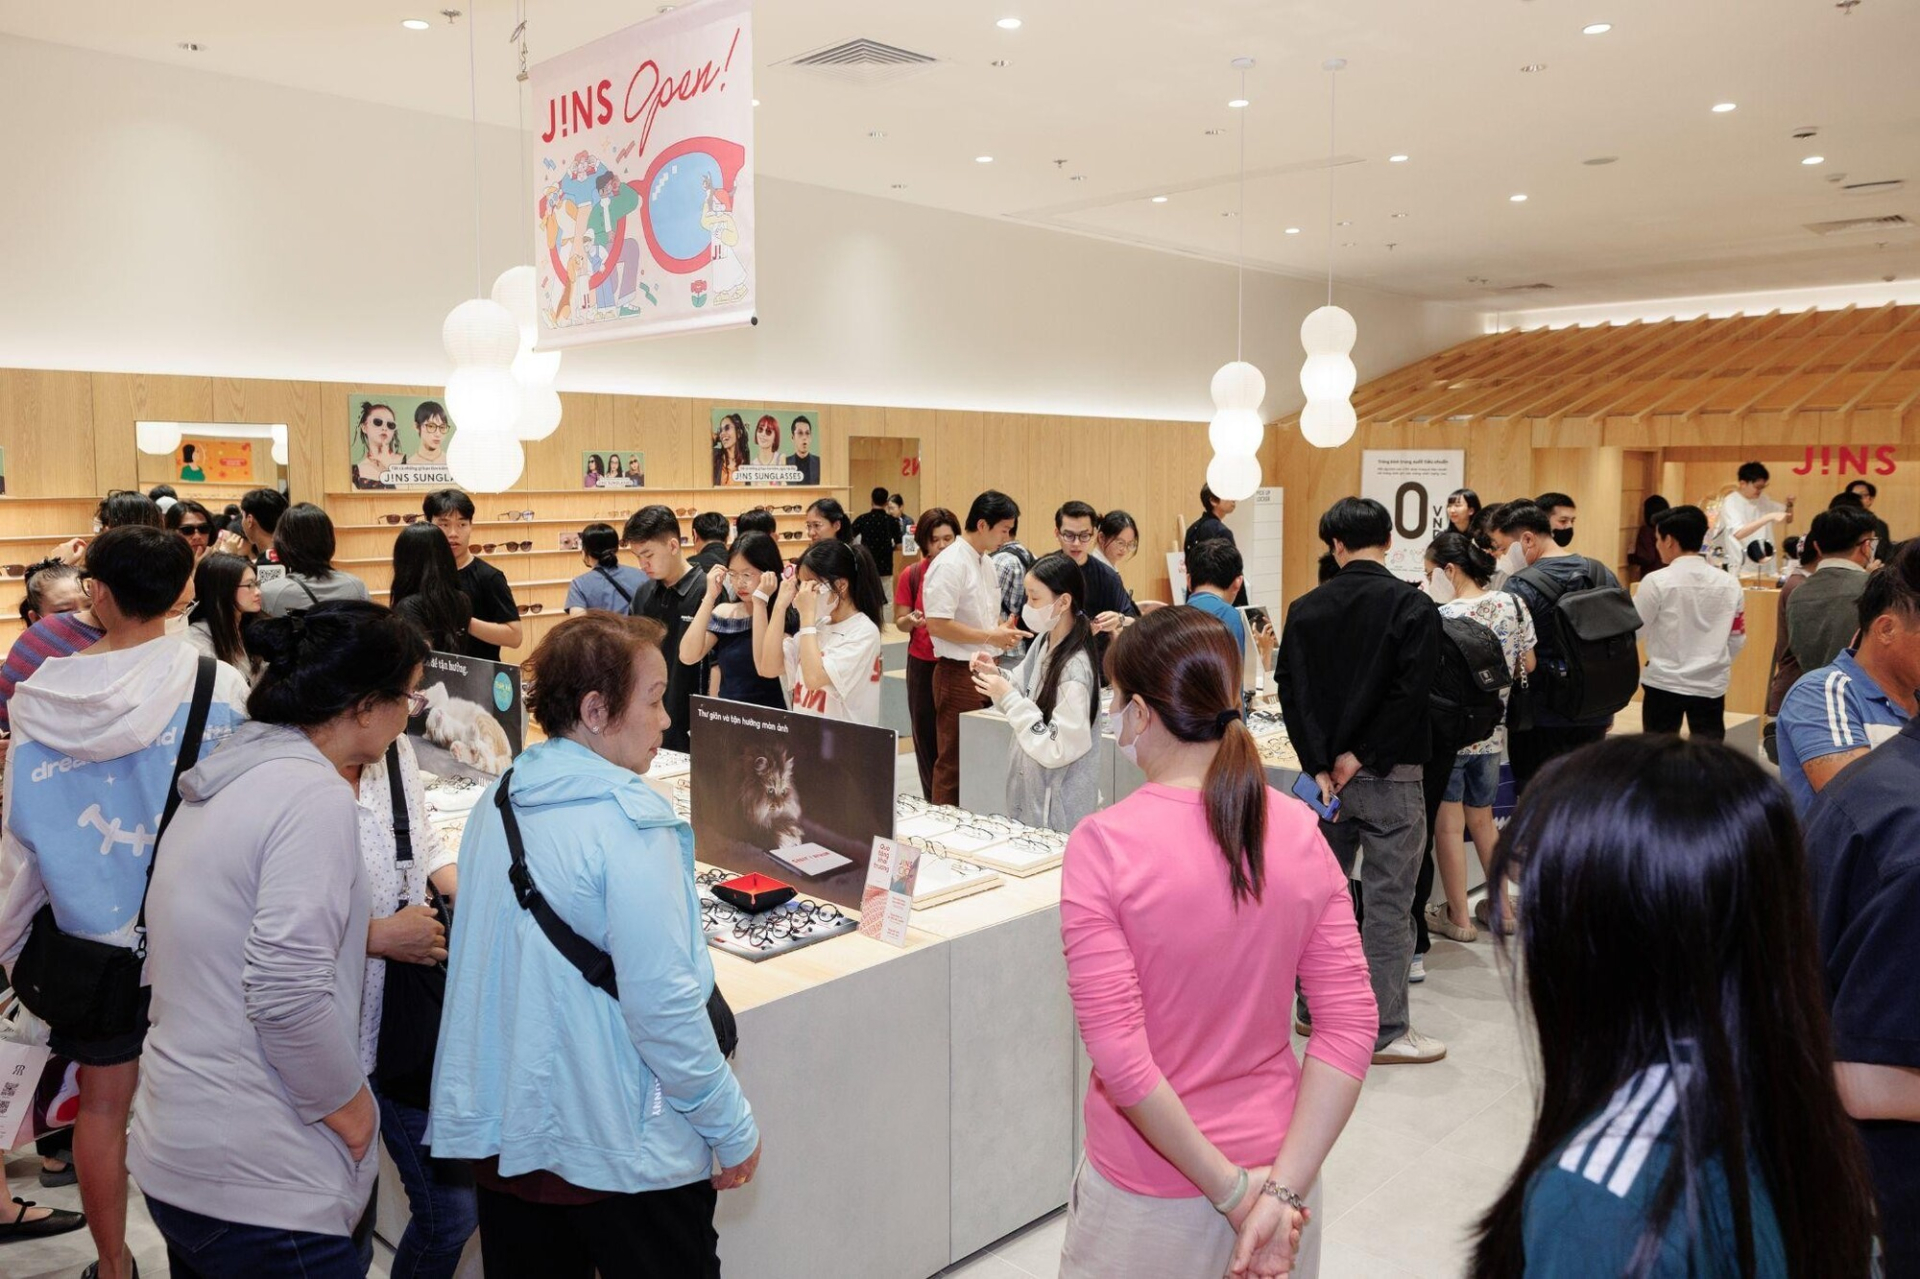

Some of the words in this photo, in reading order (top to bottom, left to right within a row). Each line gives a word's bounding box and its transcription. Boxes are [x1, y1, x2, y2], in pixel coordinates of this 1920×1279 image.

[541, 79, 614, 144] J!NS
[624, 27, 740, 157] Open!
[1792, 444, 1897, 476] J!NS
